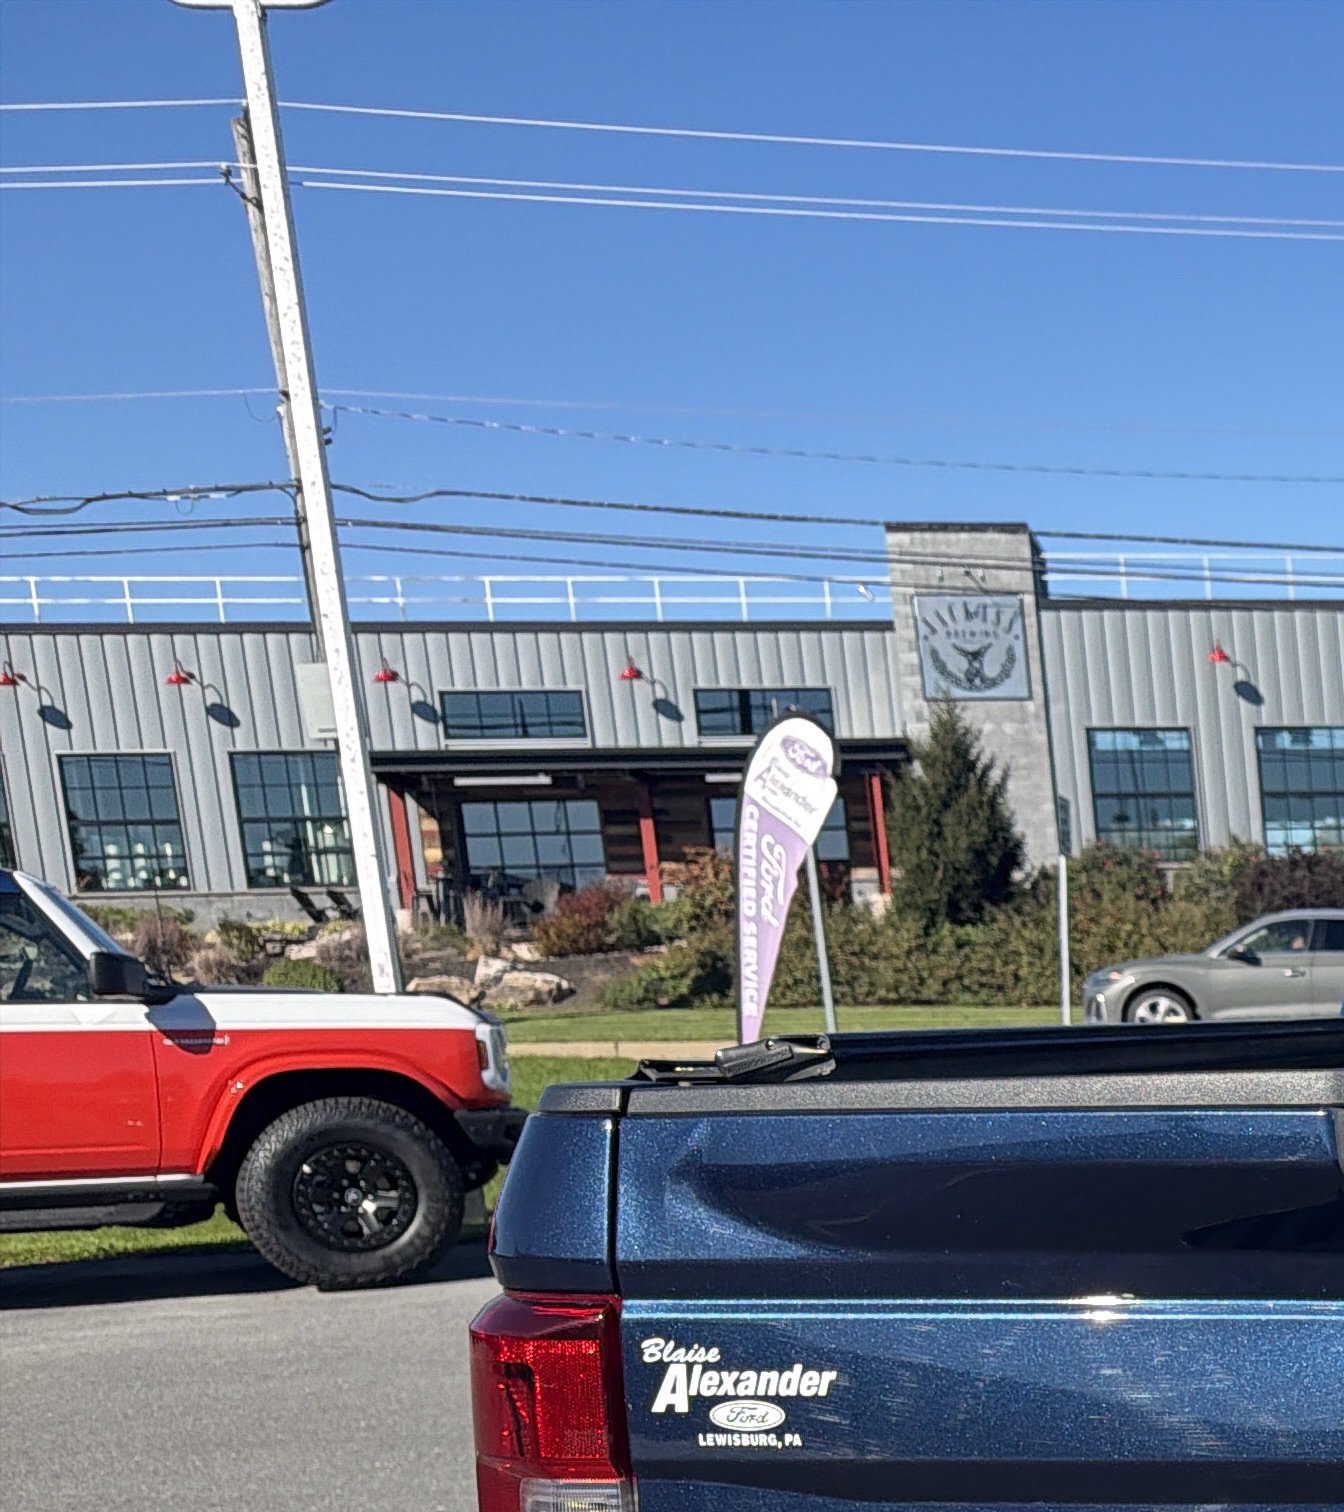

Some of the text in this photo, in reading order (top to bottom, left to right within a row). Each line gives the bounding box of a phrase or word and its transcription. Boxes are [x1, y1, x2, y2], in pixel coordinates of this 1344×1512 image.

[761, 834, 787, 928] Ford
[742, 804, 759, 1017] CERTIFIED SERVICE
[640, 1337, 721, 1363] Blaise
[651, 1363, 837, 1413] Alexander
[726, 1406, 769, 1424] Ford
[698, 1433, 802, 1449] LEWISBURG, PA
